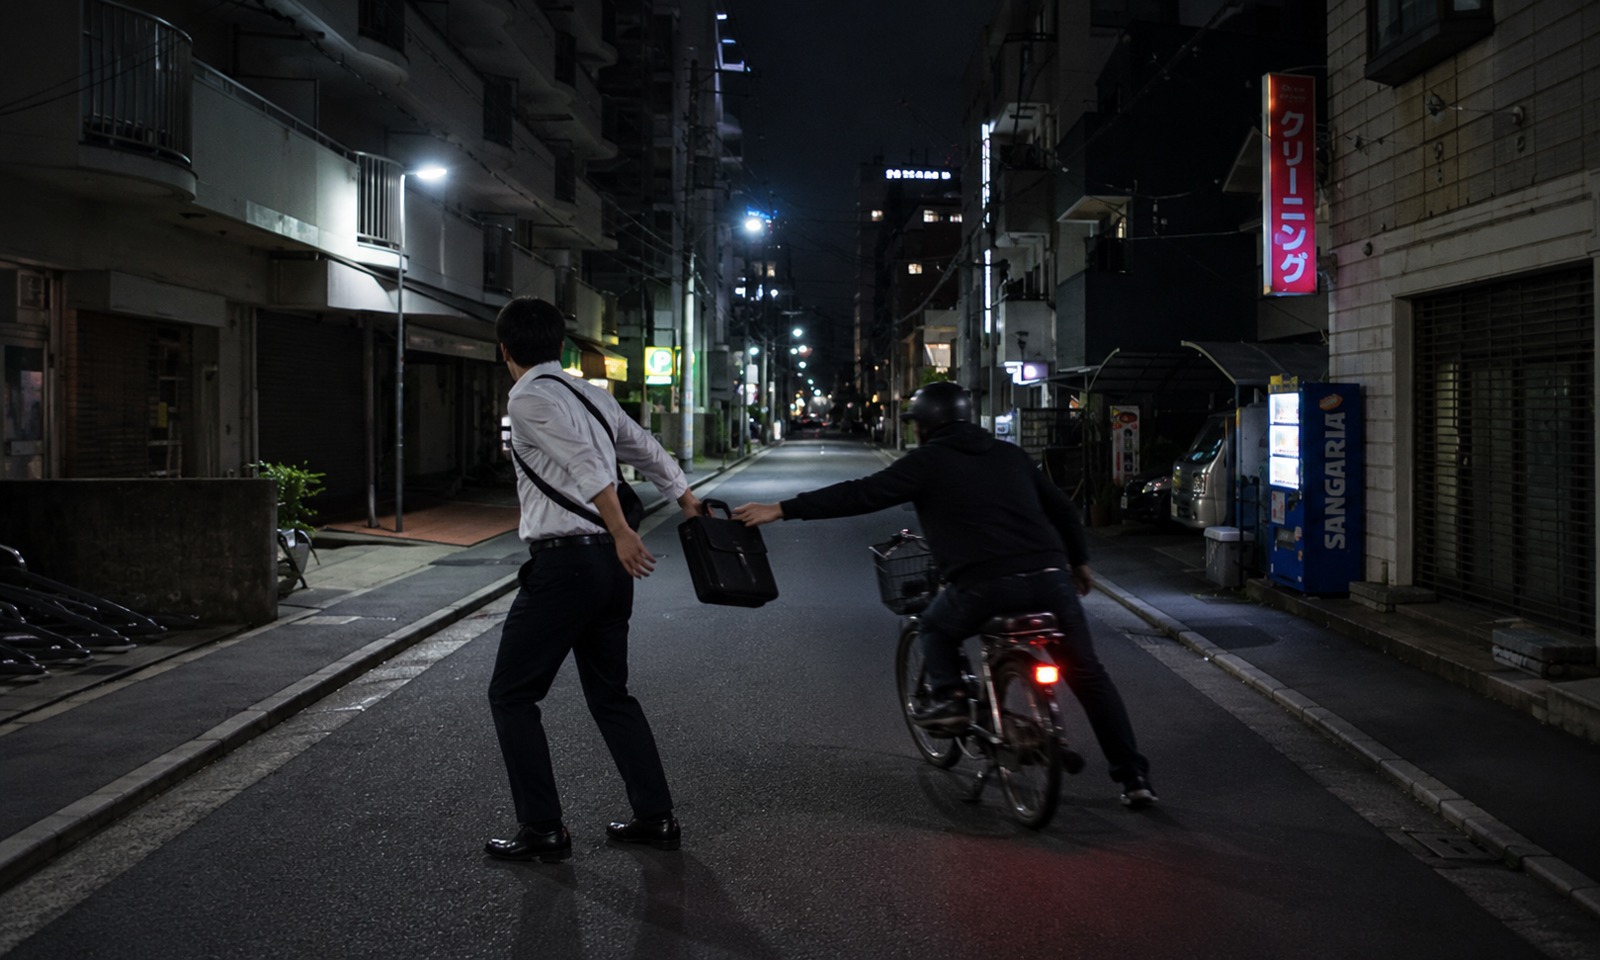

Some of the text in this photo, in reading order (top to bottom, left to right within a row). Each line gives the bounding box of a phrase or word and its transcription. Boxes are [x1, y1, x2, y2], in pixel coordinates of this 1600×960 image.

[1281, 111, 1308, 283] クリーニング
[653, 350, 671, 373] P
[1325, 412, 1346, 549] SANGARIA
